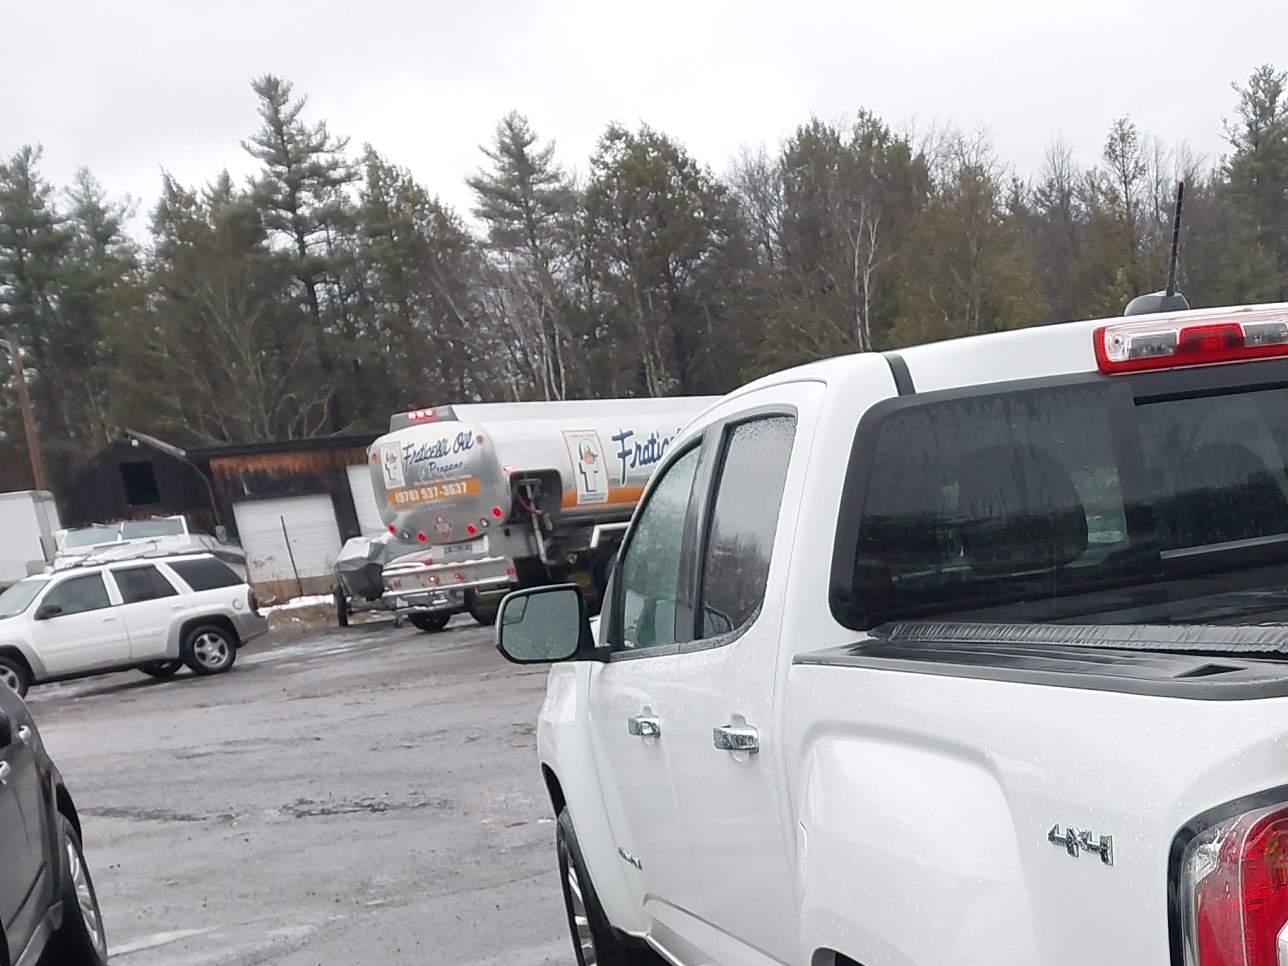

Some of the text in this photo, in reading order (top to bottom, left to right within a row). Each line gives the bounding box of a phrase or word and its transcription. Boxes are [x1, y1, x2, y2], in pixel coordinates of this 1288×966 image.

[402, 430, 474, 475] Fraticelli Oil
[611, 428, 682, 486] Fratic
